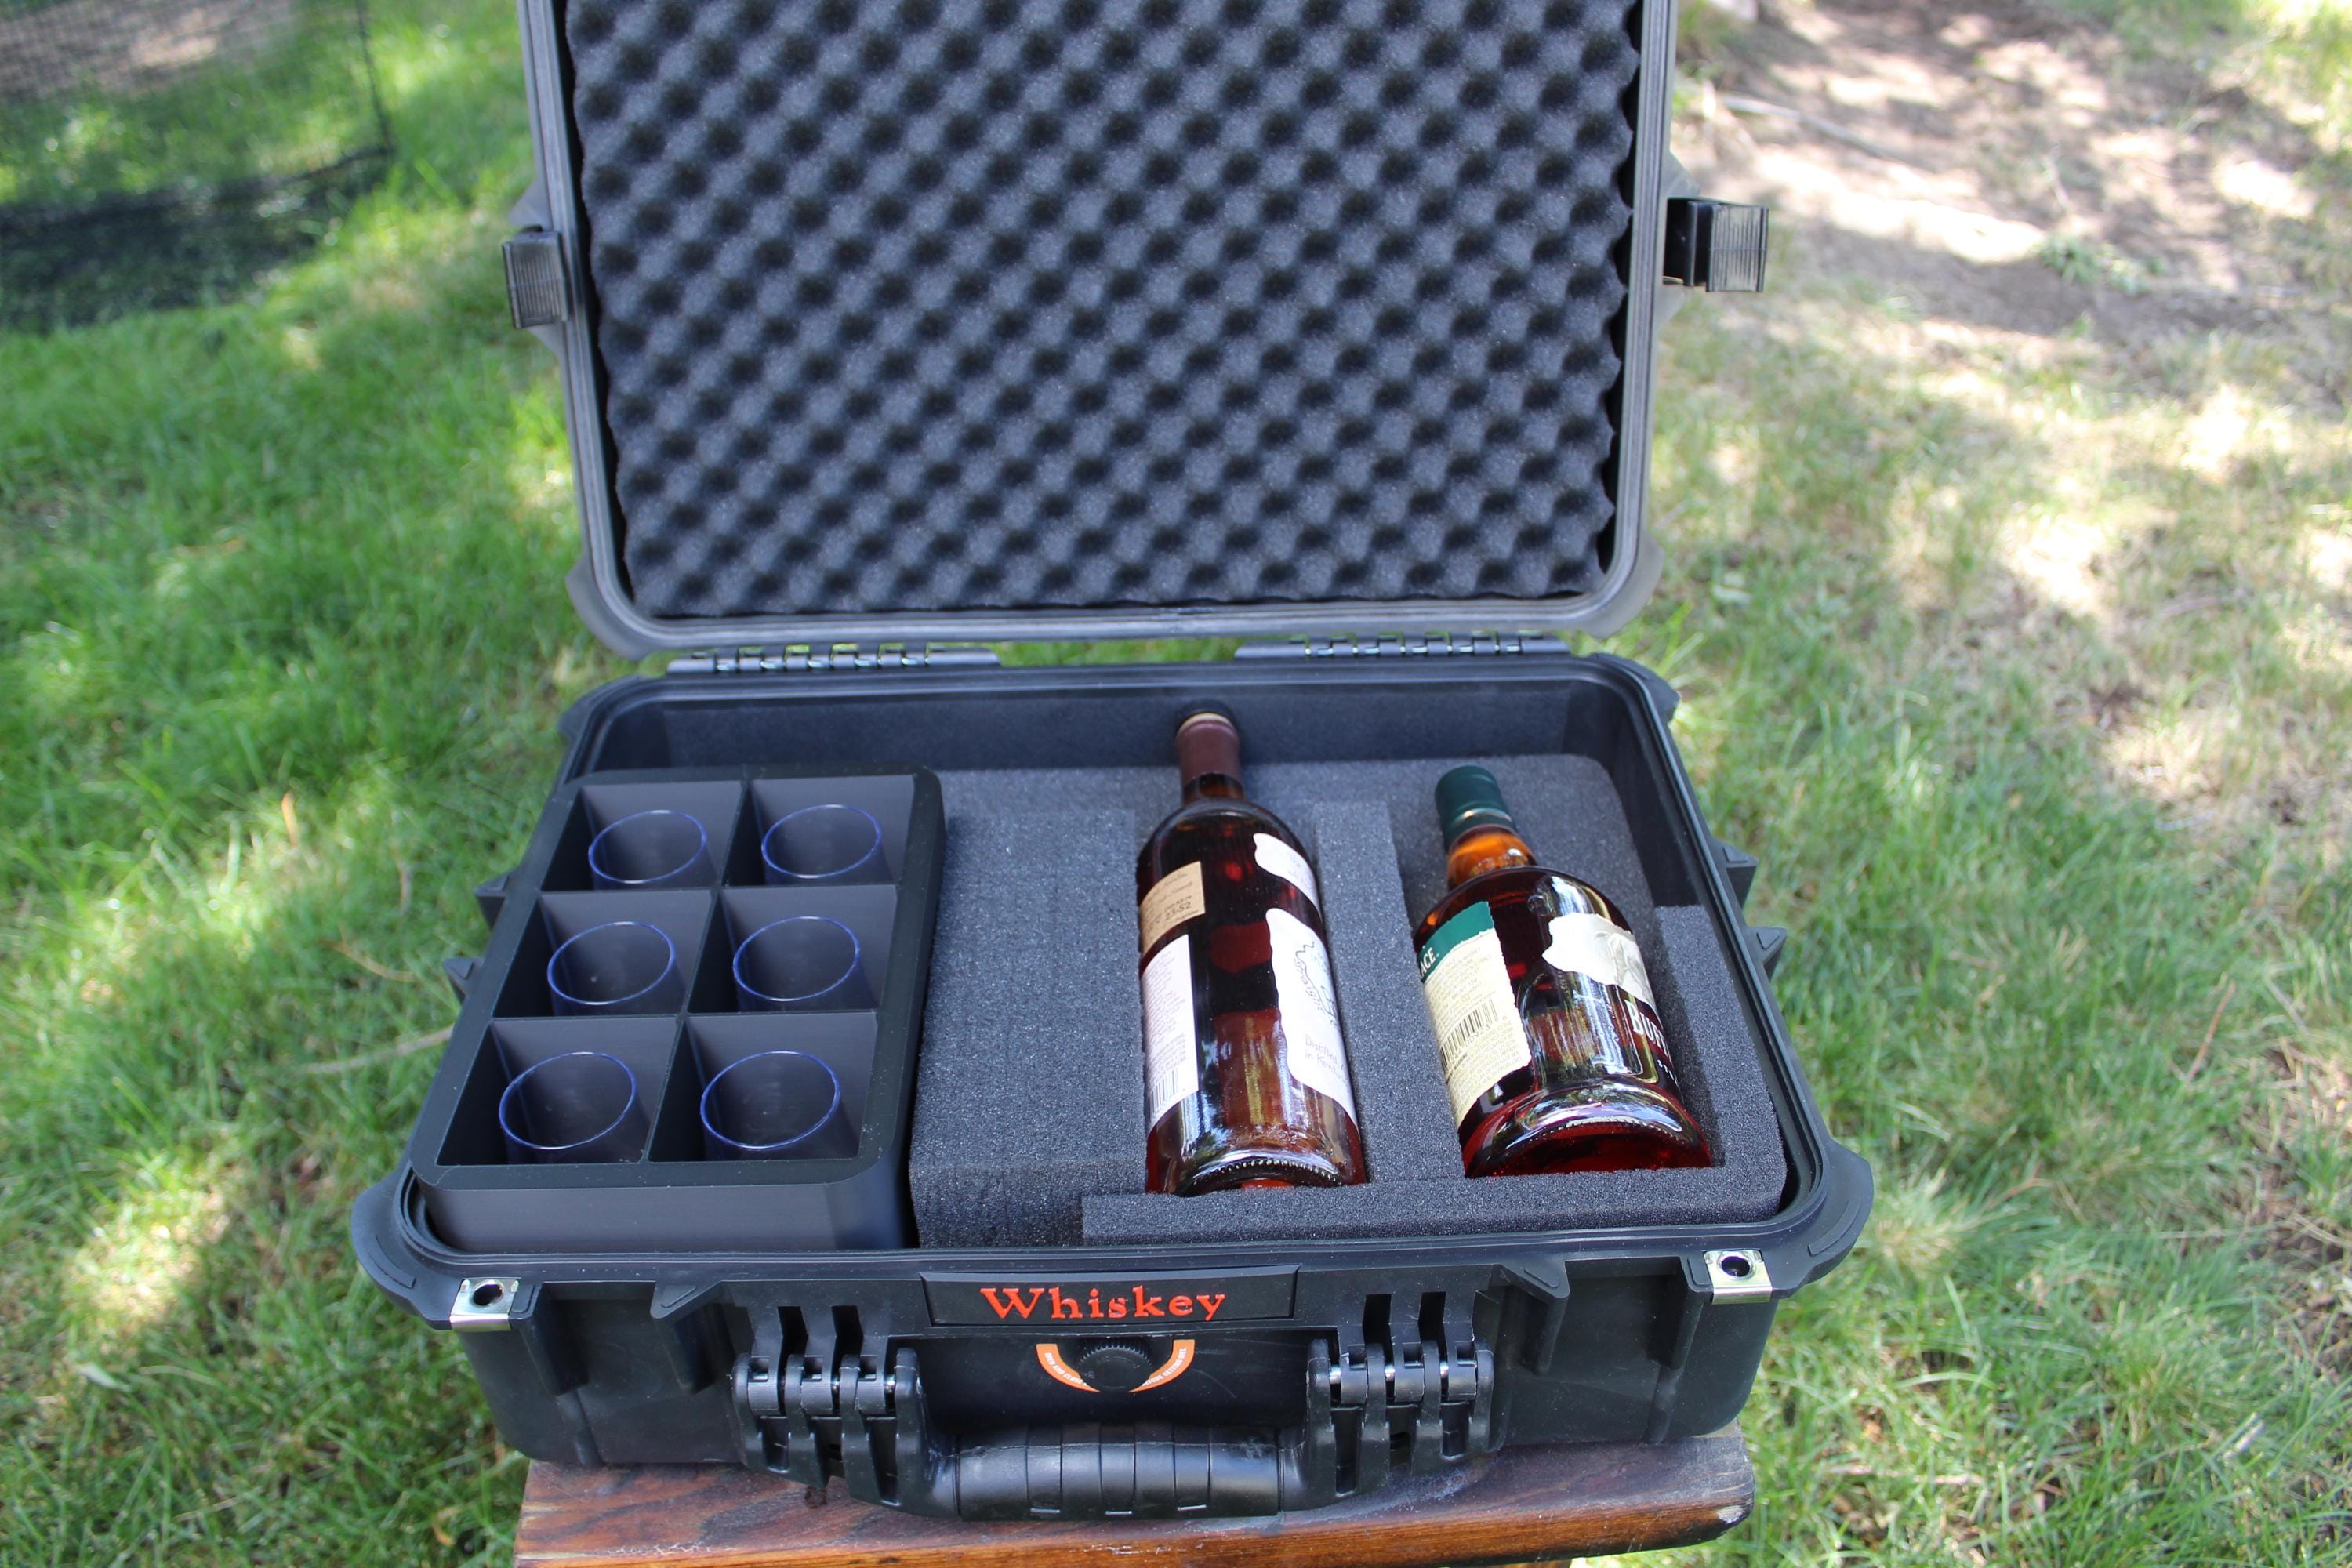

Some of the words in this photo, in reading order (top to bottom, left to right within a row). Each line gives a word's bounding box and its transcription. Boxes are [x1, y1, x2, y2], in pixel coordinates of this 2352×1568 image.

[1419, 947, 1436, 979] ACE
[1624, 999, 1671, 1060] BUFF
[980, 1285, 1225, 1322] Whiskey
